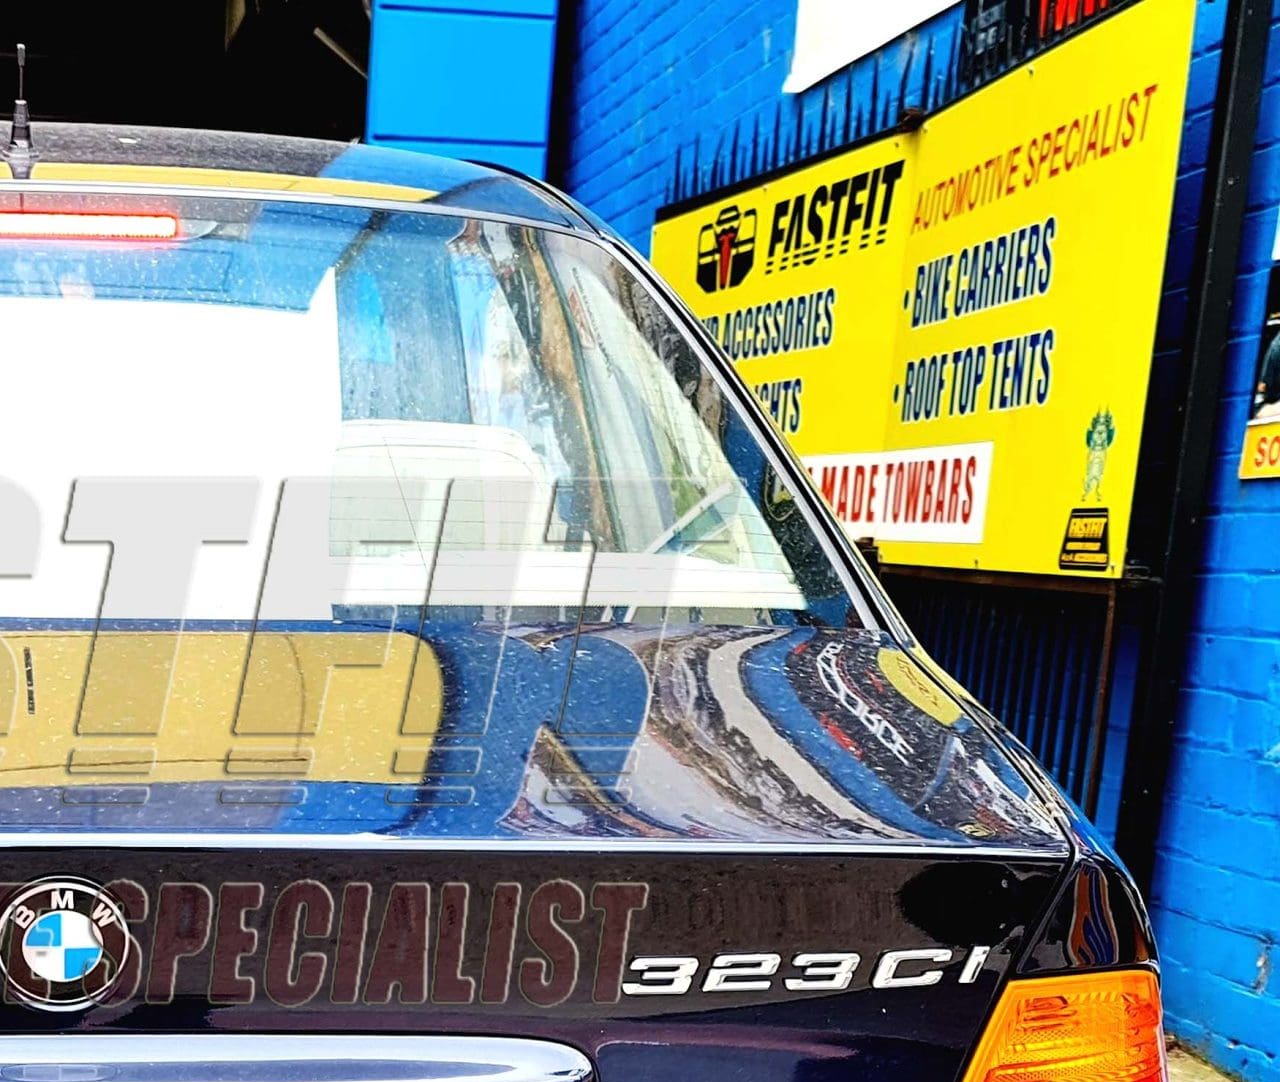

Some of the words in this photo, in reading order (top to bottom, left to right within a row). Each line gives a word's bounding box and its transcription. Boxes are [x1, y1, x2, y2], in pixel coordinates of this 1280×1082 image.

[911, 145, 1022, 235] AUTOMOTIVE
[1023, 84, 1158, 188] SPECIALIST
[765, 159, 905, 275] FASTFIT
[912, 254, 954, 328] BIKE
[954, 217, 1055, 317] CARRIERS
[722, 288, 835, 361] ACCESSORIES
[901, 354, 949, 422] ROOF
[949, 345, 987, 416] TOP
[989, 329, 1054, 411] TENTS
[821, 465, 879, 523] MADE
[883, 456, 976, 524] TOWBARS
[9, 890, 117, 929] BMW
